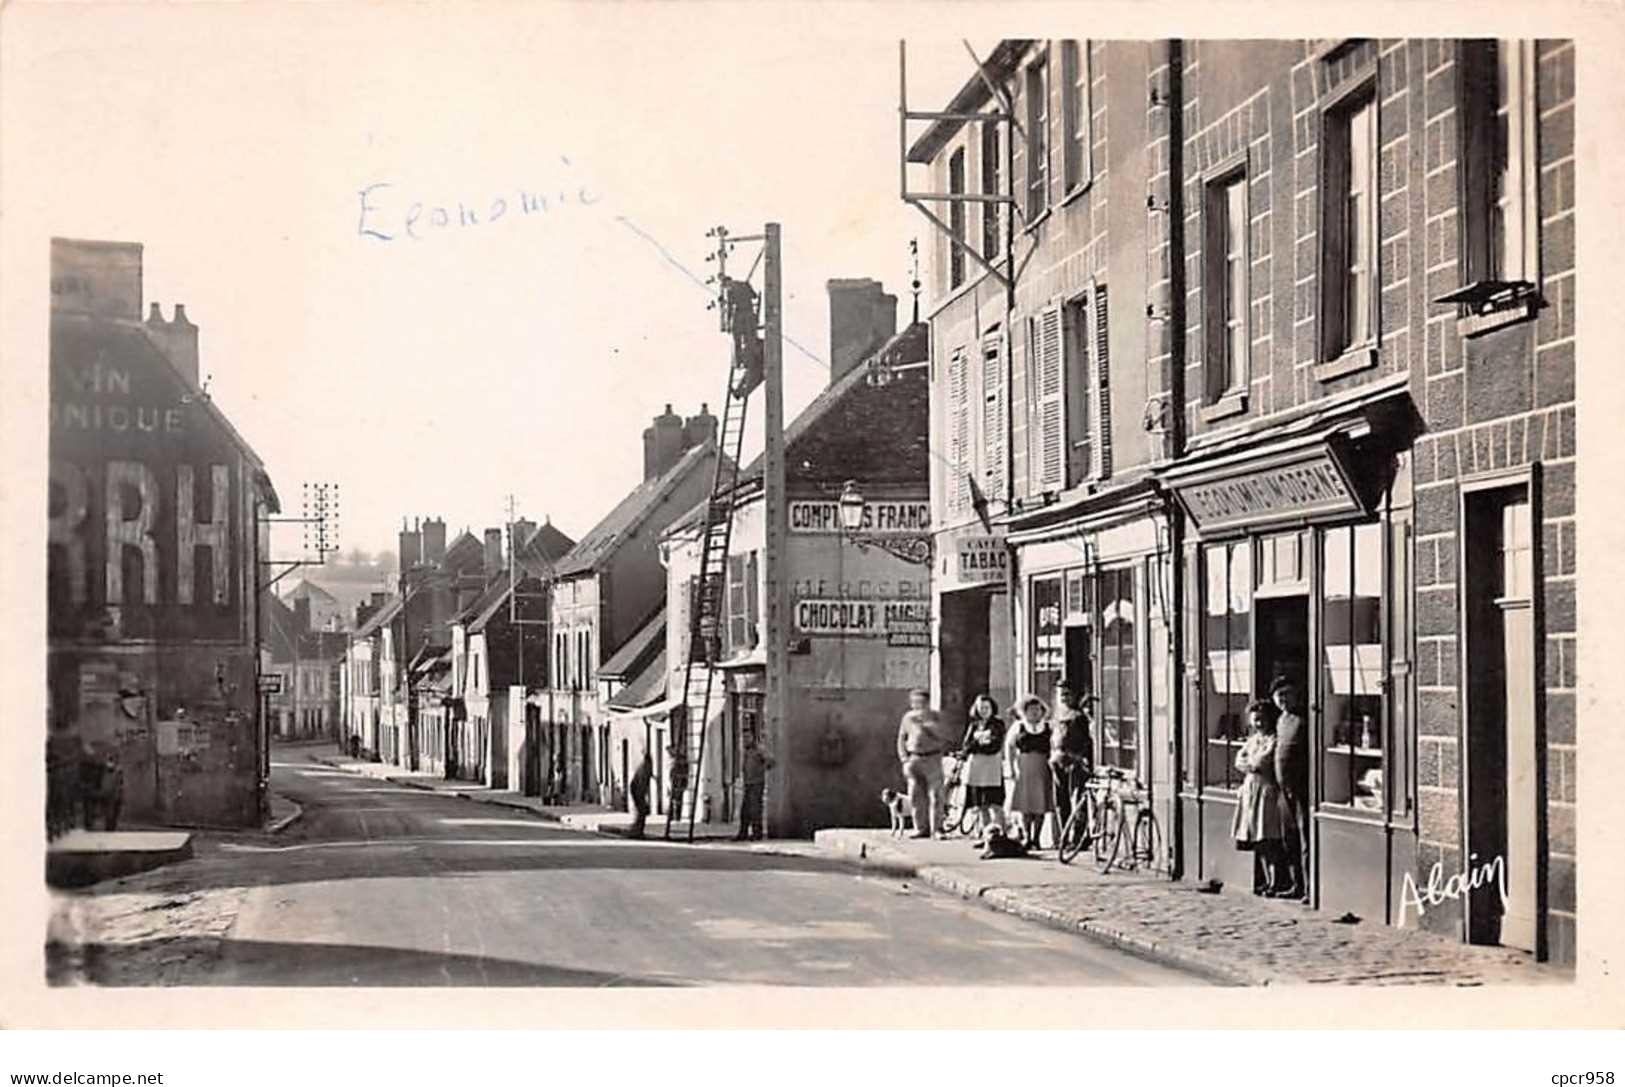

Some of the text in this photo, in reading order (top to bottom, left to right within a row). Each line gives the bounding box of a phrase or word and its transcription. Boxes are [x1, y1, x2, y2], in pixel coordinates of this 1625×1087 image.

[65, 366, 129, 394] VIN
[52, 405, 182, 432] NIQUE
[1265, 464, 1345, 505] MODERNE
[792, 504, 873, 529] COMPTS
[961, 552, 1006, 569] TABAC
[799, 602, 874, 629] CHOCOLAT
